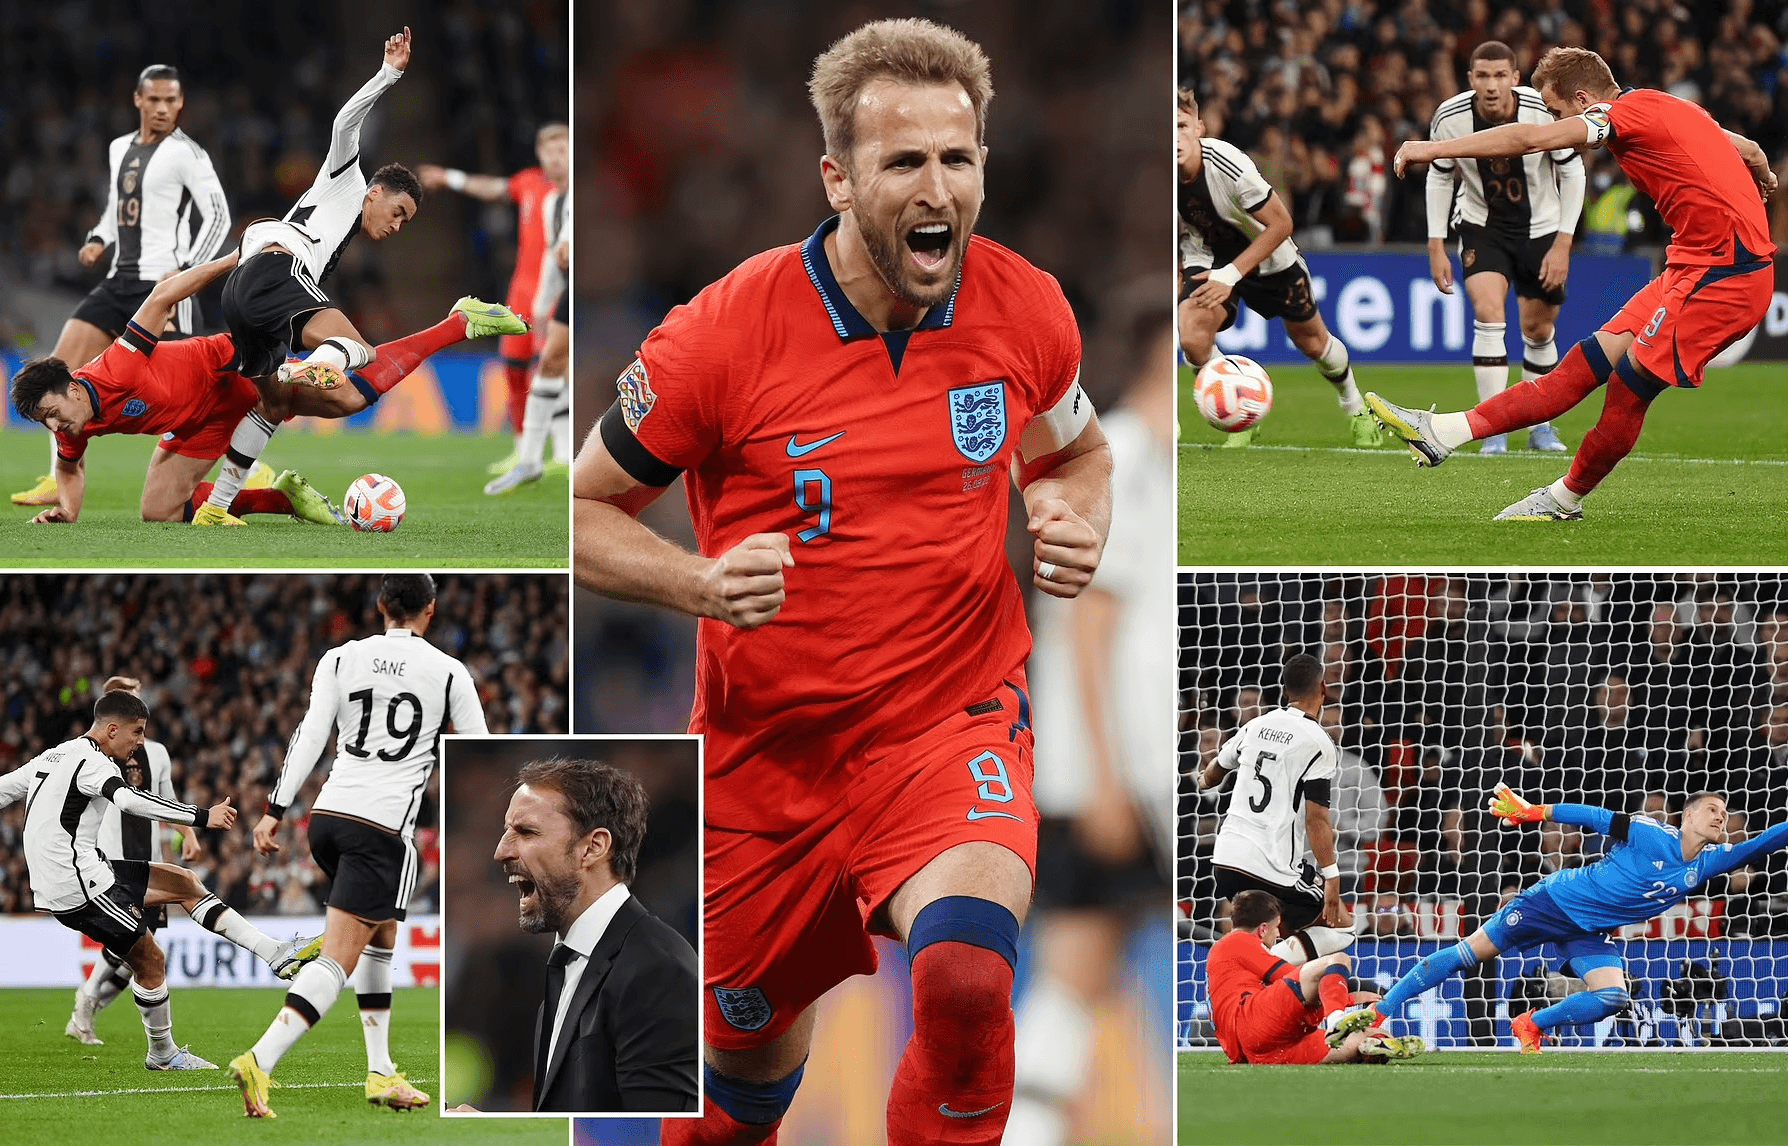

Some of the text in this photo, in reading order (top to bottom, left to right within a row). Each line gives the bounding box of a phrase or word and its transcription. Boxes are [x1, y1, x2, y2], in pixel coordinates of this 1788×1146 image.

[1487, 177, 1523, 203] 20
[118, 197, 140, 227] 19
[1645, 306, 1667, 338] 9
[794, 468, 833, 543] 9
[372, 658, 406, 676] SANÉ
[345, 687, 423, 762] 19
[1258, 727, 1294, 745] KEHRER
[25, 770, 50, 822] 7
[966, 749, 1014, 803] 9
[1249, 750, 1272, 813] 5
